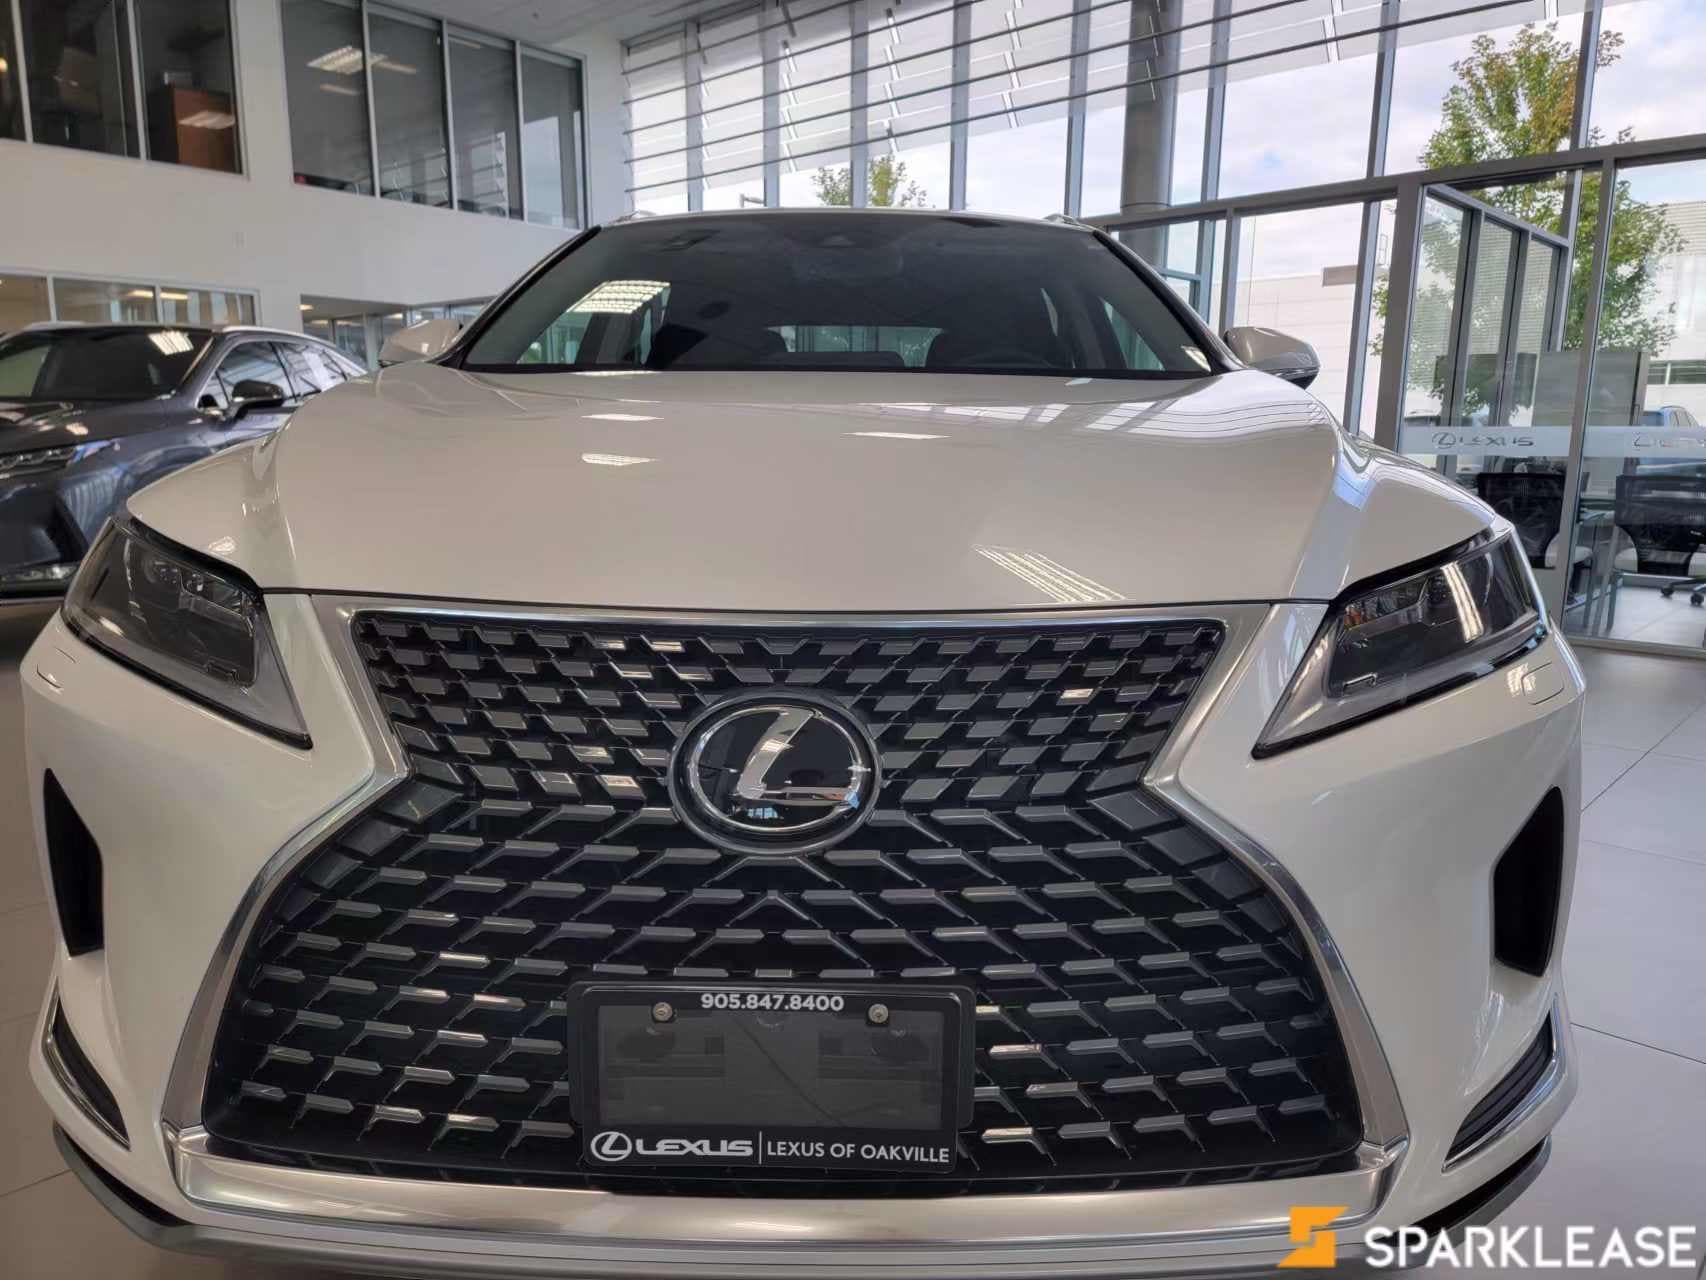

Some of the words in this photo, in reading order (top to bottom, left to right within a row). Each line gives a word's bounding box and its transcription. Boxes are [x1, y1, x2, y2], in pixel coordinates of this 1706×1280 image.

[701, 993, 845, 1011] 905.847.8400
[635, 1138, 754, 1157] LEXUS
[767, 1141, 825, 1157] LEXUS
[830, 1143, 855, 1158] OF
[860, 1144, 950, 1163] OAKVILLE
